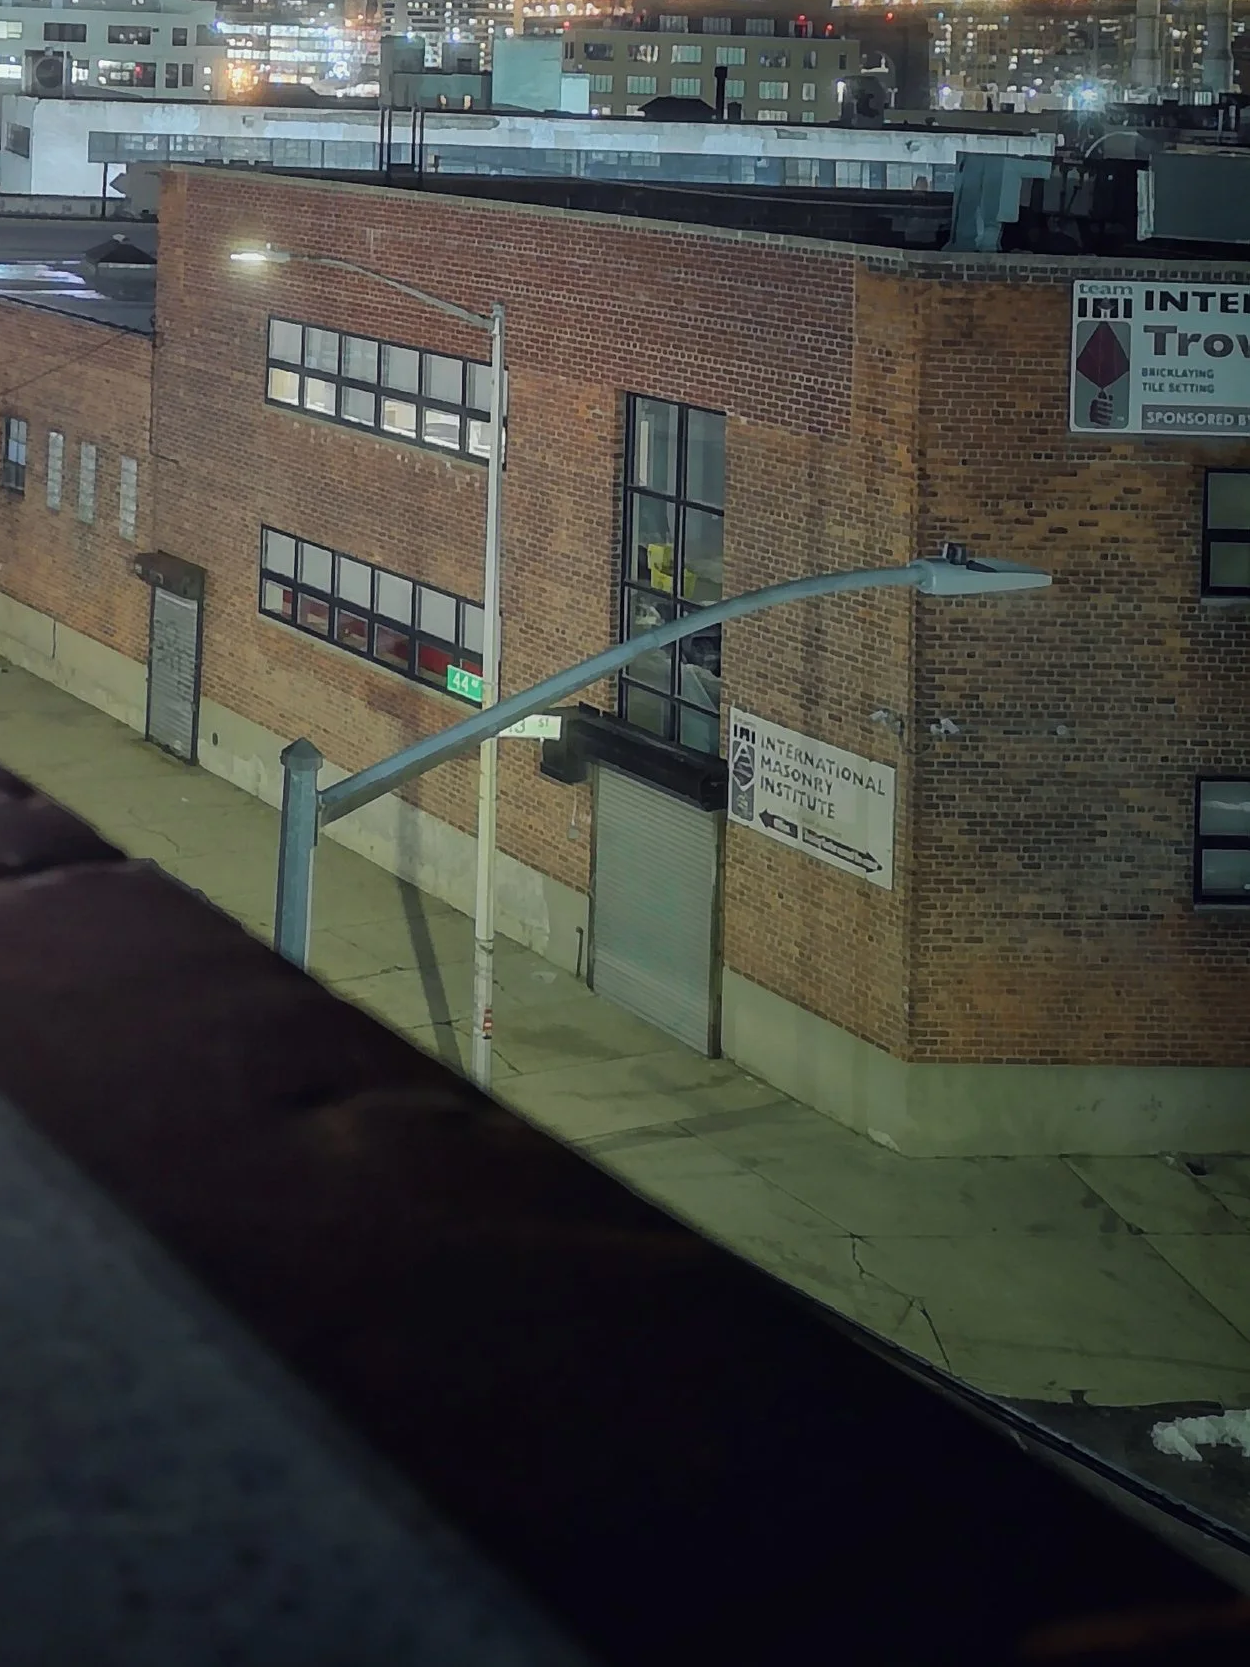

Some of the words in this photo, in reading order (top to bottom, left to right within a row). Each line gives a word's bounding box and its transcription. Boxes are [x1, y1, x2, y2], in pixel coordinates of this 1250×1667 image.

[1079, 283, 1133, 295] team
[1141, 367, 1215, 379] BRICKLAYING
[1142, 381, 1163, 393] TILE
[1168, 382, 1215, 394] SETTING
[1146, 411, 1234, 427] SPONSORED
[1238, 413, 1250, 427] B
[452, 671, 469, 693] 44
[761, 734, 886, 796] INTERNATIONAL
[761, 755, 833, 796] MASONRY
[761, 775, 835, 820] INSTITUTE
